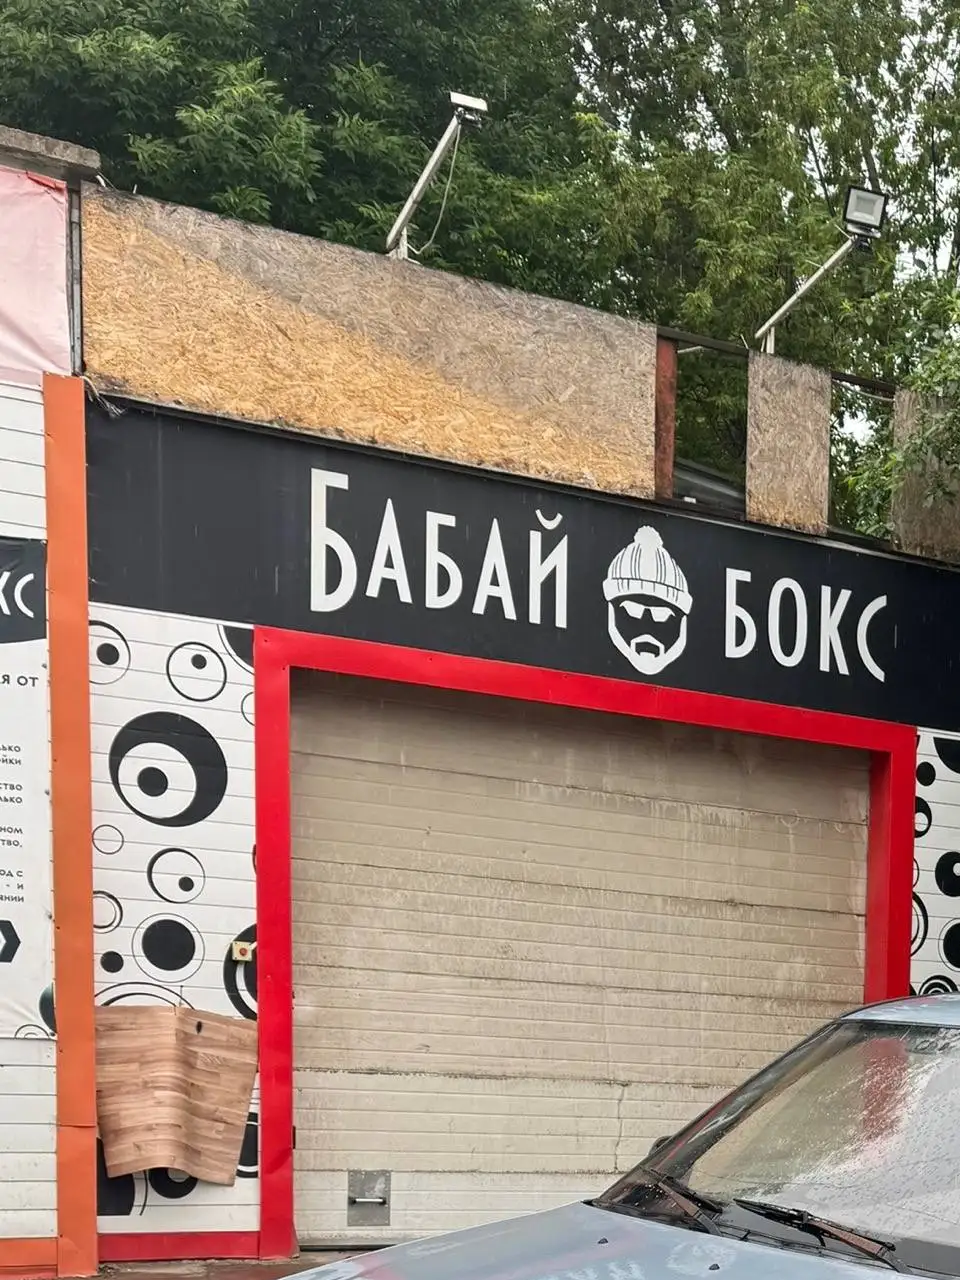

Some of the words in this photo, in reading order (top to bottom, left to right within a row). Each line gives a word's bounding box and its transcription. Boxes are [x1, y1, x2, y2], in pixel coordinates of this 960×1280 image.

[310, 467, 568, 629] БАБАЙ
[724, 568, 888, 682] БОКС
[16, 675, 39, 687] ОТ
[0, 754, 22, 766] ЙКИ
